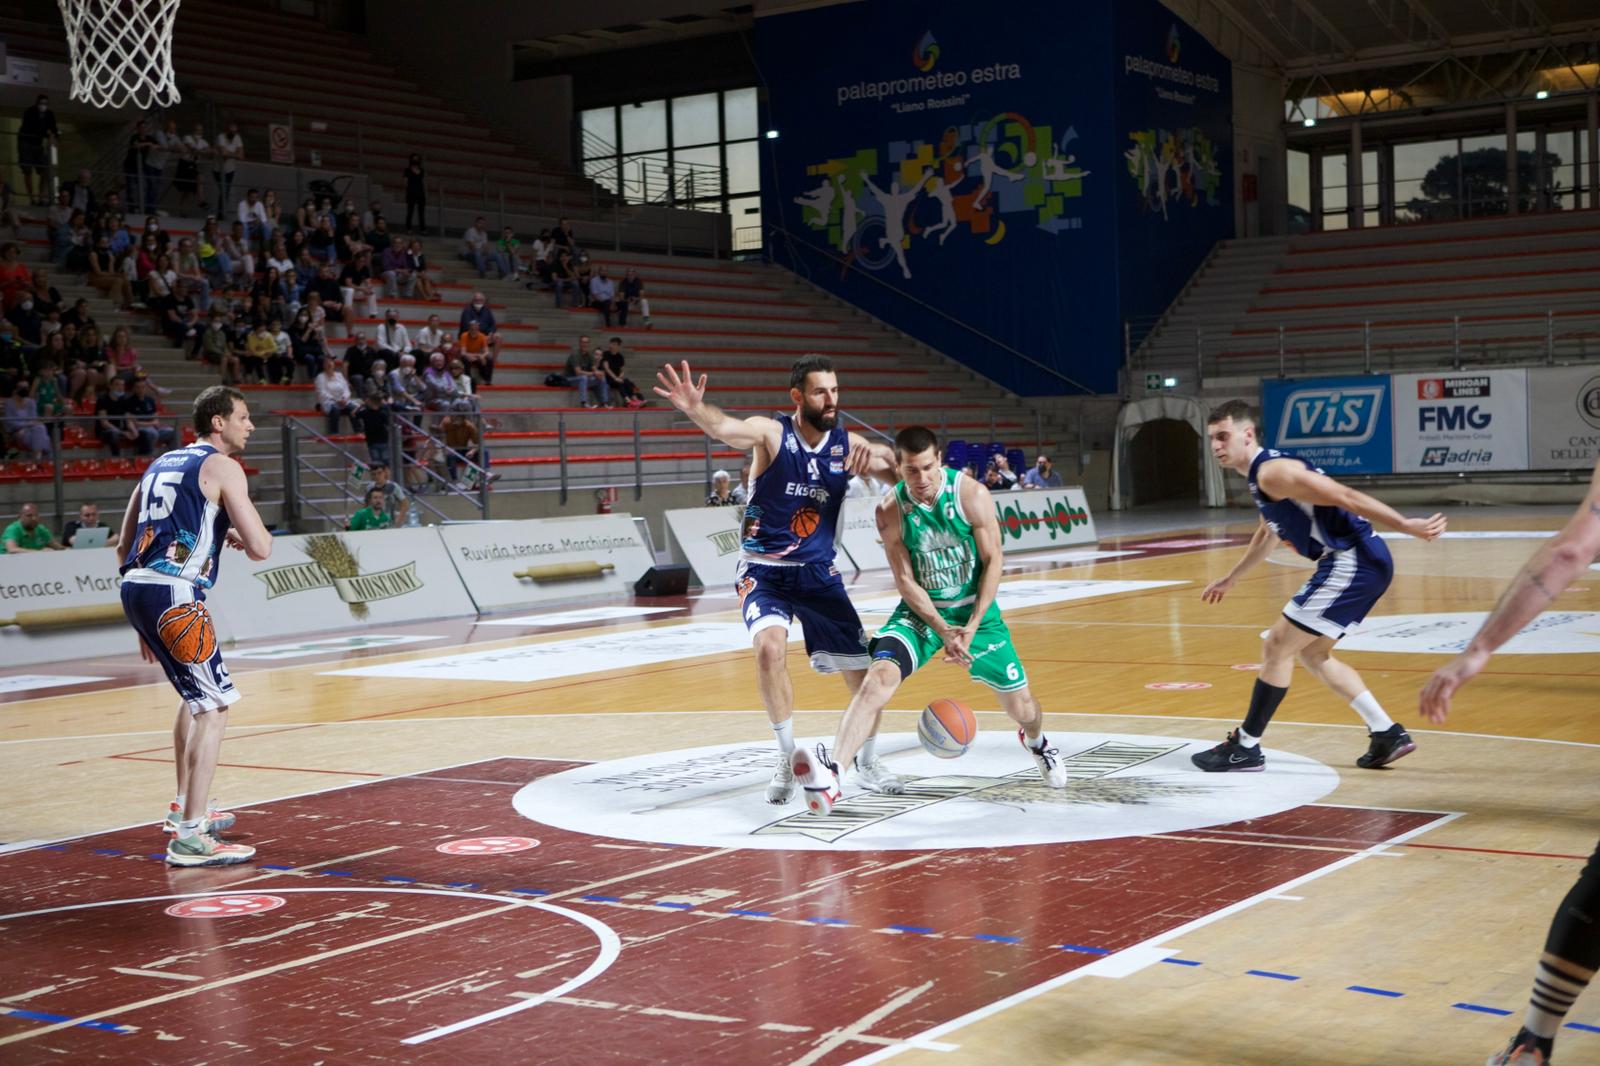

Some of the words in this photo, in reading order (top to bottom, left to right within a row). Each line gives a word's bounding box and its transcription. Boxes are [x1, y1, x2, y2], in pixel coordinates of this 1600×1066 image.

[1125, 55, 1194, 86] palaprometeo
[837, 71, 967, 107] palaprometeo
[971, 62, 1021, 84] estra
[1445, 379, 1488, 388] MINOAN
[1453, 388, 1480, 396] LINES
[1419, 405, 1492, 432] FMG
[1296, 447, 1346, 458] INDUSTRIE
[1447, 448, 1492, 463] adria
[1551, 449, 1591, 460] DELLE
[807, 458, 820, 480] 4
[138, 471, 185, 524] 15
[264, 563, 332, 595] LUCIANA
[348, 567, 416, 600] MOSCONI
[0, 580, 71, 599] tenace.
[745, 601, 761, 621] 4
[1006, 662, 1019, 681] 6
